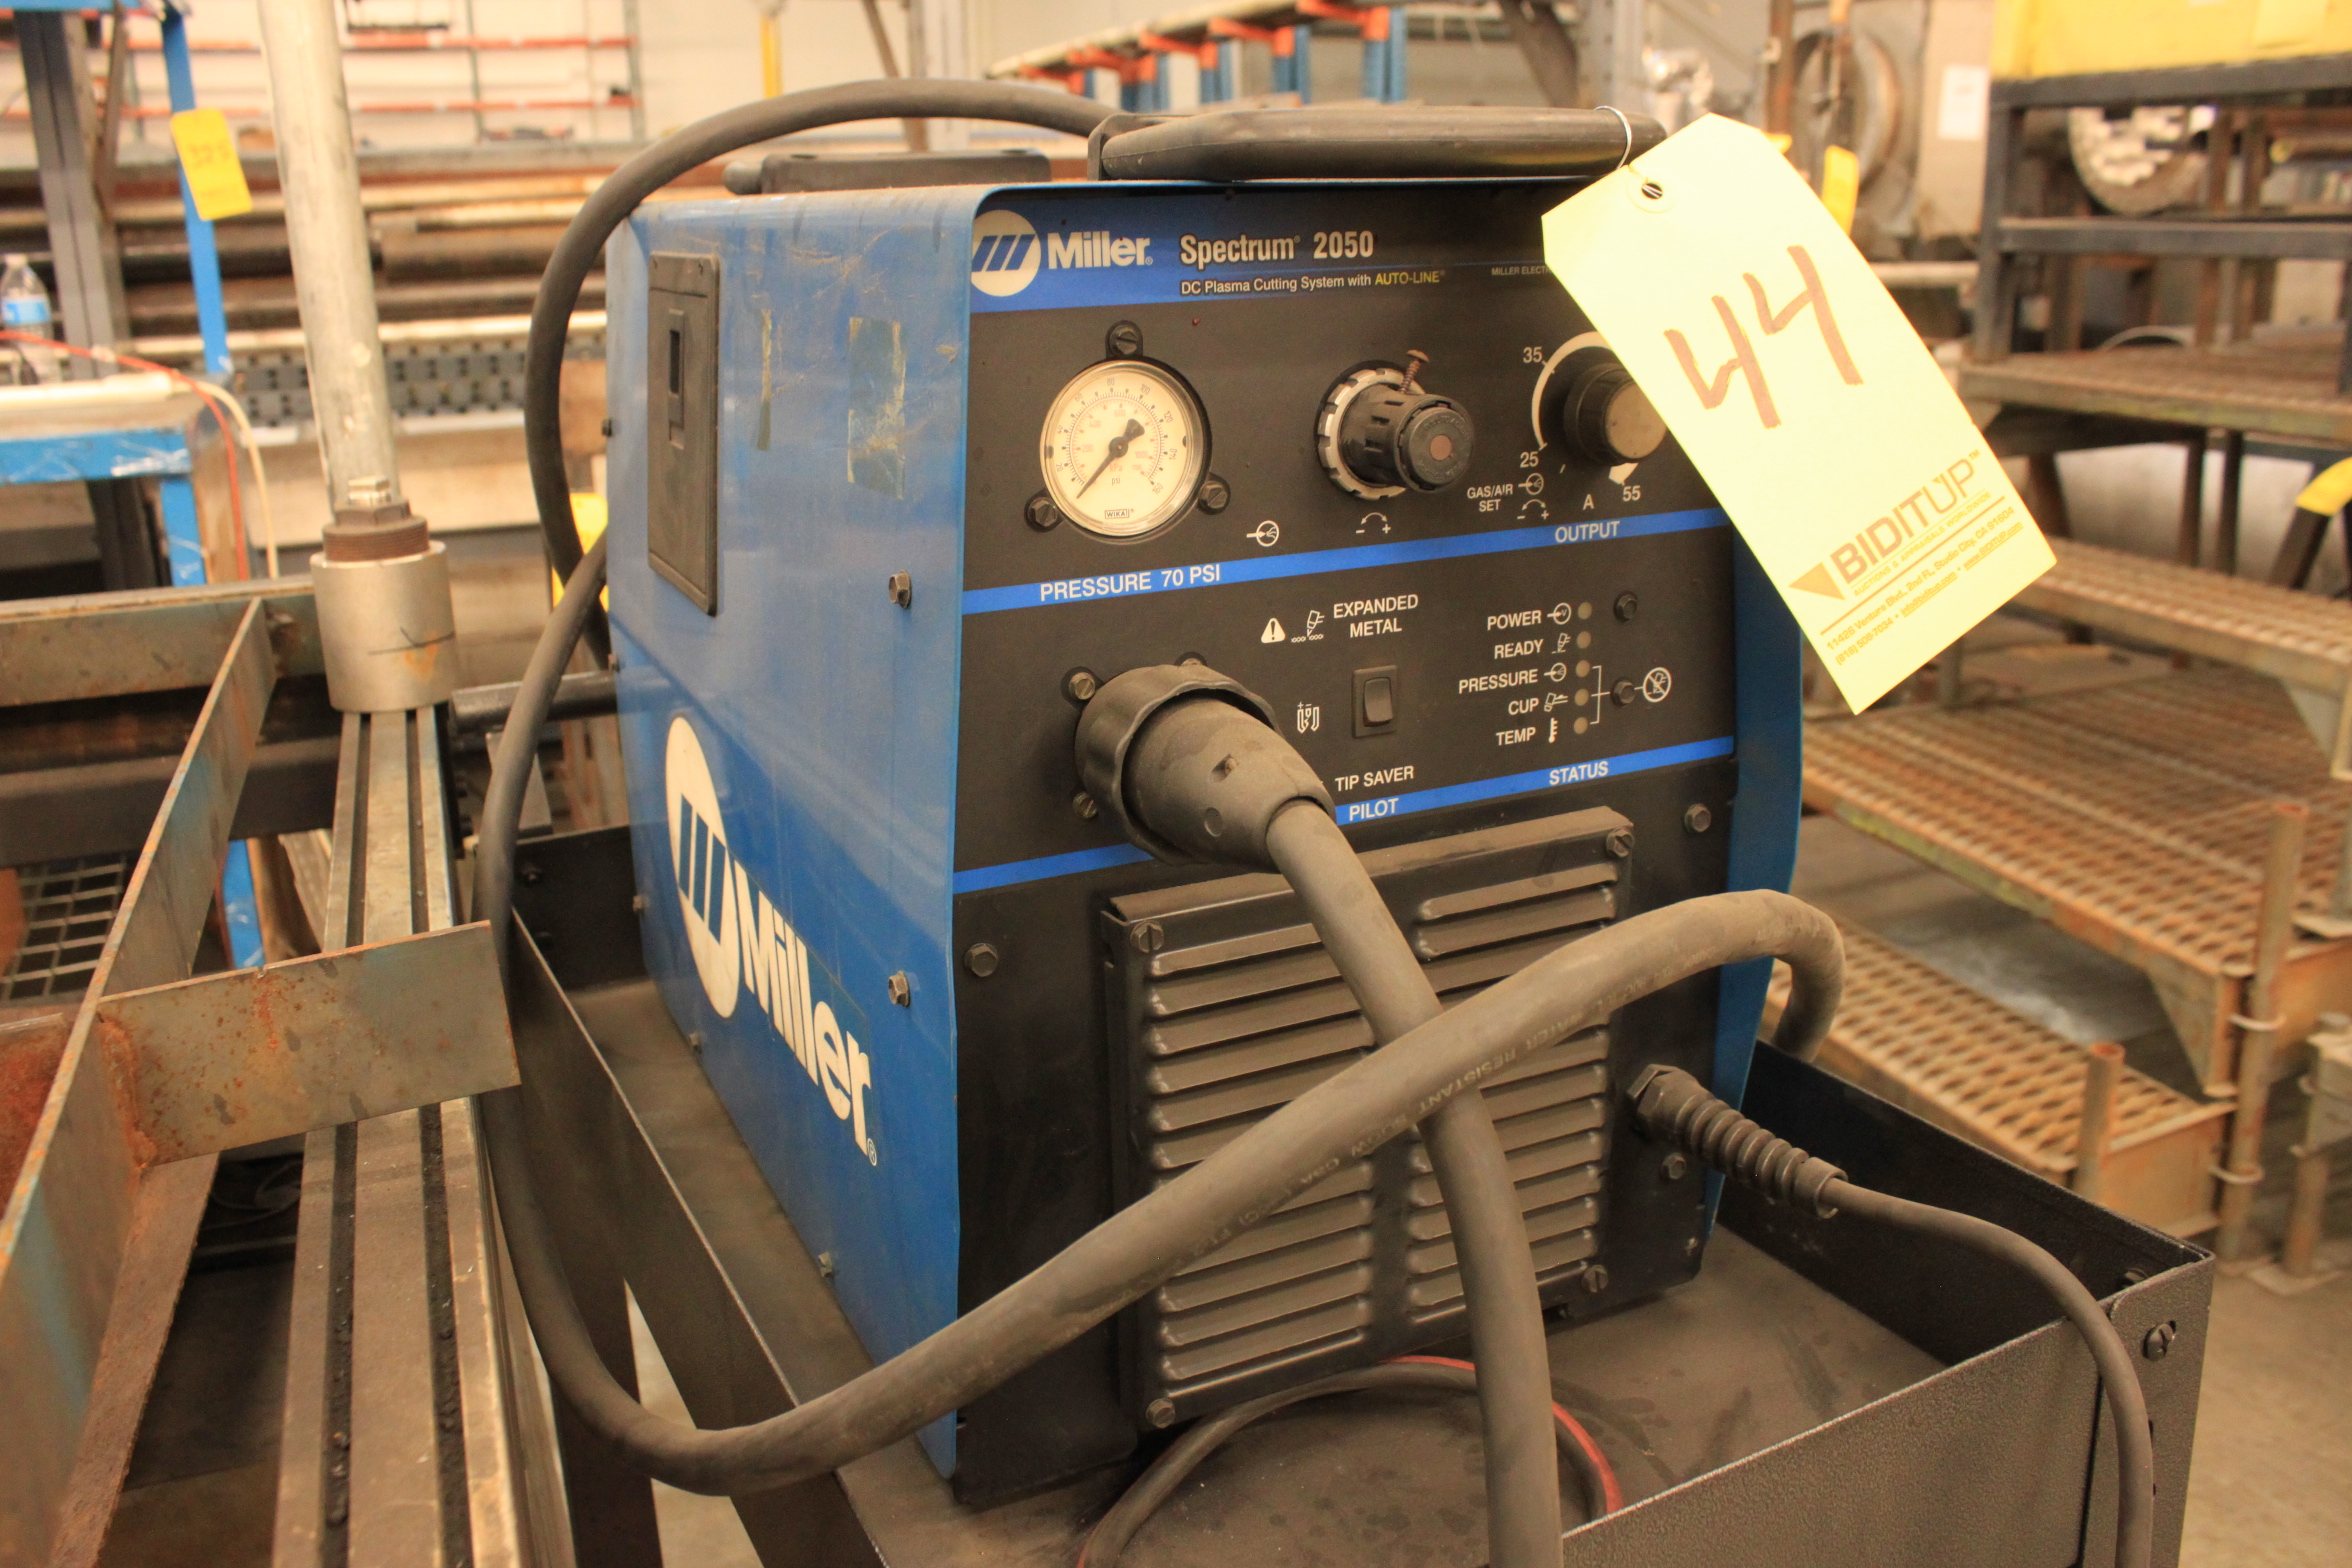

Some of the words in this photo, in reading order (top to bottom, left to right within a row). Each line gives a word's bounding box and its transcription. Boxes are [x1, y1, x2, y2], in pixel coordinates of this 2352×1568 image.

[1047, 231, 1152, 269] Miller
[1180, 234, 1295, 270] Spectrum
[1313, 230, 1374, 259] 2050
[1491, 267, 1520, 276] MILLER
[1181, 280, 1202, 295] DC
[1205, 278, 1250, 293] Plasma
[1253, 276, 1297, 294] Cutting
[1300, 274, 1345, 292] System
[1347, 273, 1372, 287] with
[1374, 269, 1440, 285] AUTO-LINE
[1663, 244, 1864, 429] 44
[1523, 346, 1543, 363] 35
[1107, 378, 1115, 386] 80
[1140, 383, 1150, 395] 100
[1075, 393, 1083, 402] 60
[1163, 410, 1173, 422] 120
[1057, 425, 1063, 434] 40
[1169, 448, 1177, 460] 140
[1520, 451, 1539, 468] 25
[1056, 464, 1063, 472] 20
[1109, 463, 1123, 472] kPa
[1111, 477, 1121, 486] psi
[1152, 483, 1164, 495] 160
[1467, 483, 1513, 499] GAS/AIR
[1582, 494, 1595, 510] A
[1622, 485, 1641, 501] 55
[1106, 510, 1126, 518] WIKA
[1478, 499, 1501, 512] SET
[1830, 458, 1975, 584] BIDITUP
[1555, 520, 1620, 543] OUTPUT
[1853, 566, 1892, 597] AUCTIONS
[1900, 526, 1946, 562] APPRAISALS
[1946, 491, 1992, 527] WORLDWIDE
[1962, 522, 2024, 571] www.BIDITUP.com
[1040, 571, 1152, 602] PRESSURE
[1161, 569, 1184, 587] 70
[1190, 564, 1220, 584] PSI
[1826, 625, 1856, 650] 11426
[1853, 604, 1887, 629] Ventura
[1905, 575, 1923, 592] 2nd
[1933, 549, 1960, 571] Studio
[1957, 537, 1977, 552] City,
[1975, 527, 1989, 539] CA
[1333, 593, 1419, 619] EXPANDED
[1350, 618, 1402, 638] METAL
[1487, 609, 1541, 630] POWER
[1494, 639, 1544, 659] READY
[1458, 669, 1538, 694] PRESSURE
[1508, 697, 1539, 715] CUP
[1496, 727, 1536, 746] TEMP
[1335, 774, 1359, 792] TIP
[1363, 765, 1414, 787] SAVER
[1549, 760, 1609, 785] STATUS
[1349, 797, 1399, 822] PILOT
[734, 859, 872, 1156] Miller
[1418, 1047, 1516, 1114] RESISTANT
